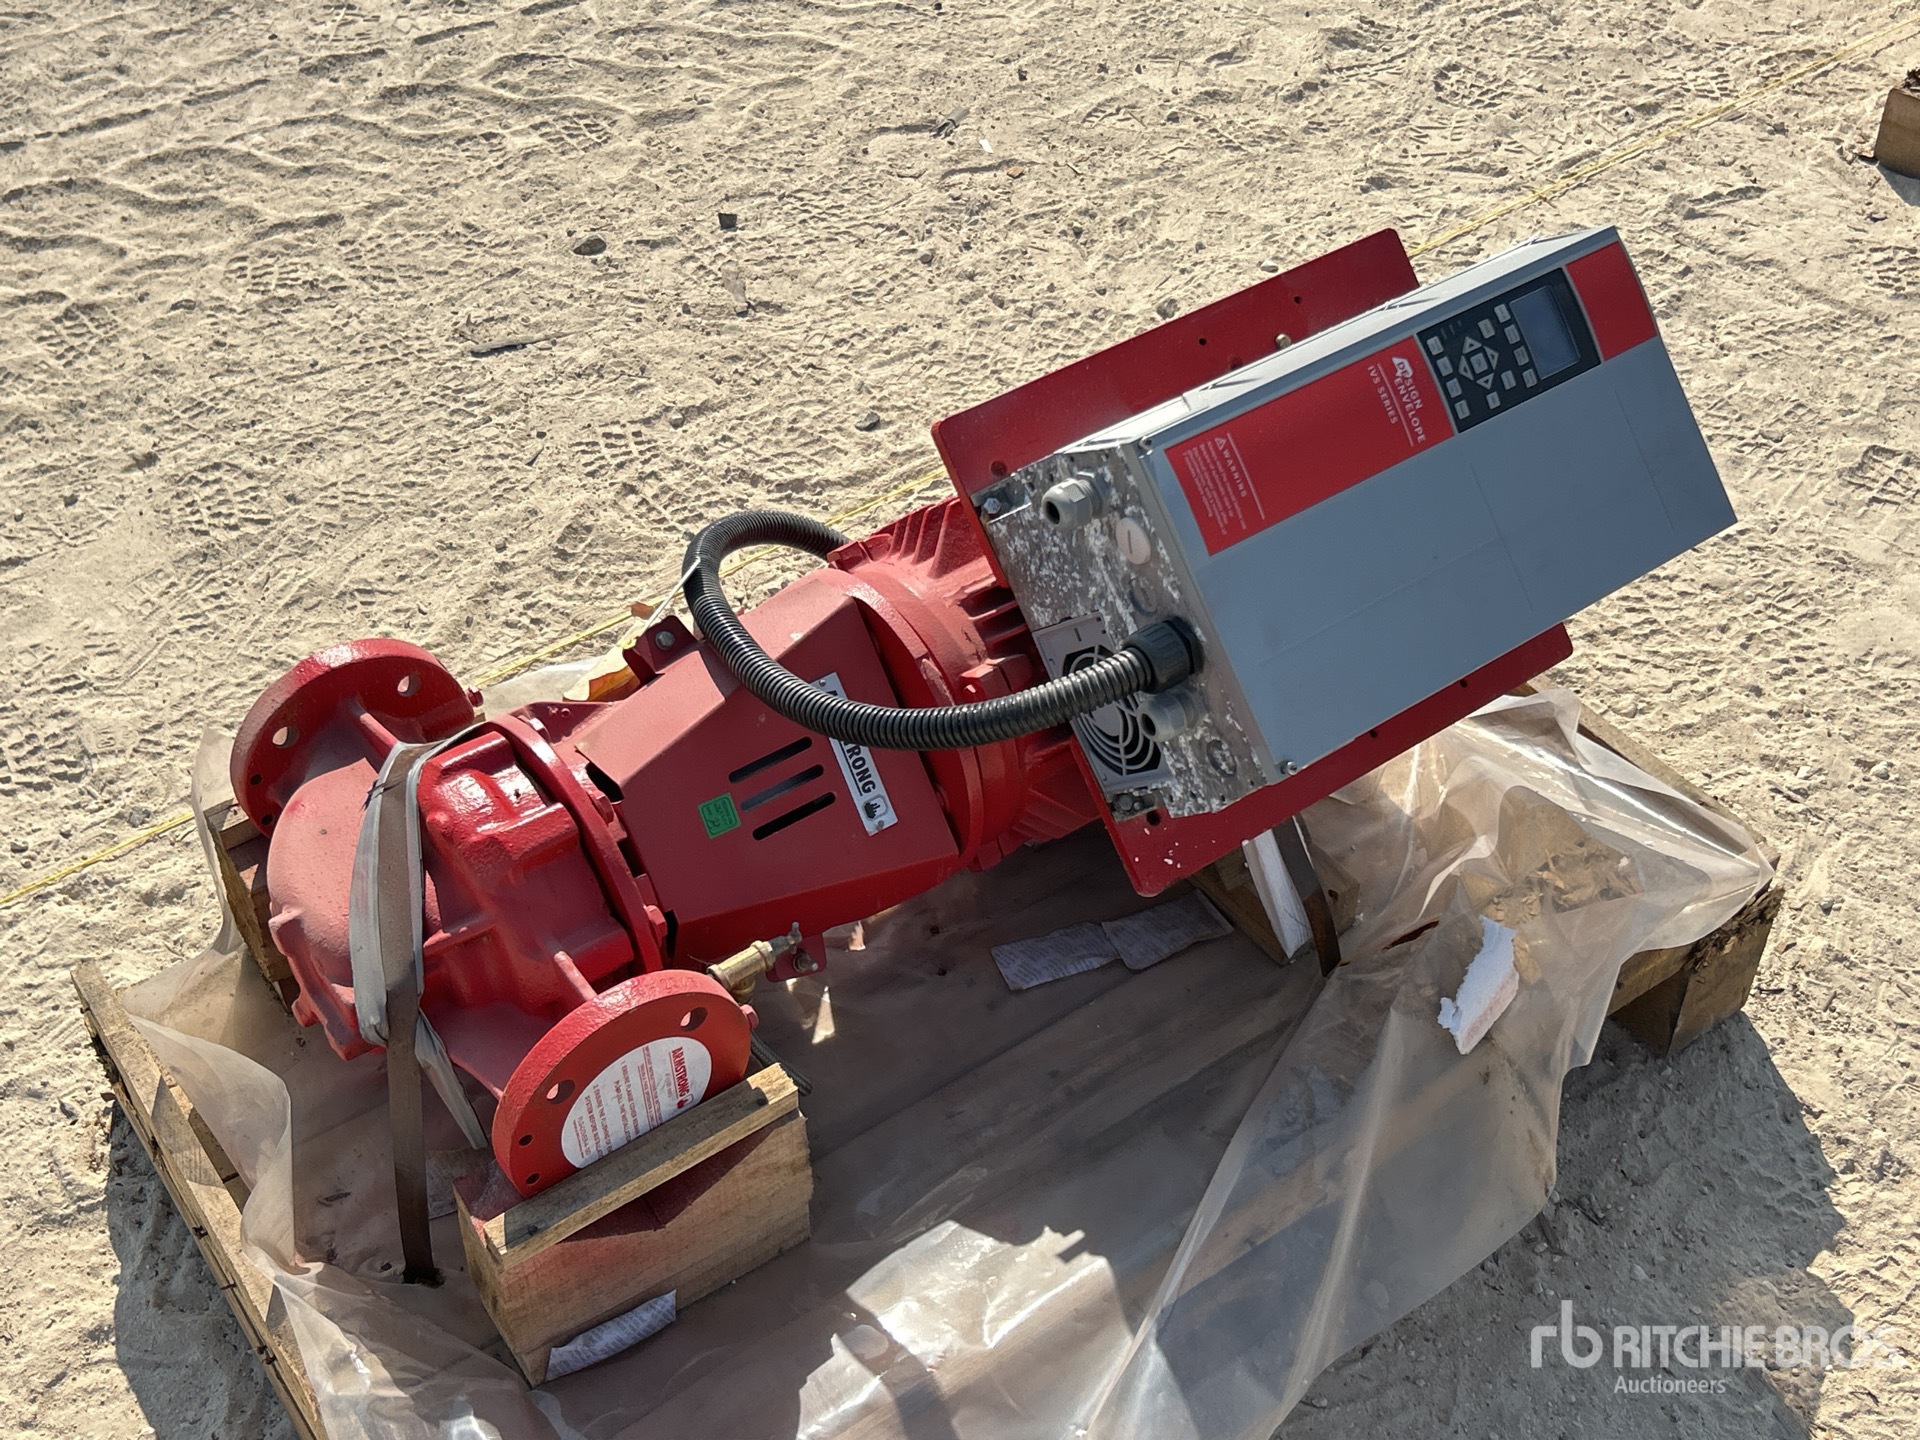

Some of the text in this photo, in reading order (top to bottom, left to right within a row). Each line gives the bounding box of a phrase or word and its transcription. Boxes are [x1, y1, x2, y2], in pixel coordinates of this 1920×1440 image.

[1367, 365, 1398, 424] IVS SERIES
[1394, 376, 1426, 444] ENVELOPE
[1223, 449, 1247, 497] WARNING
[672, 1047, 688, 1096] ARMSTRONG
